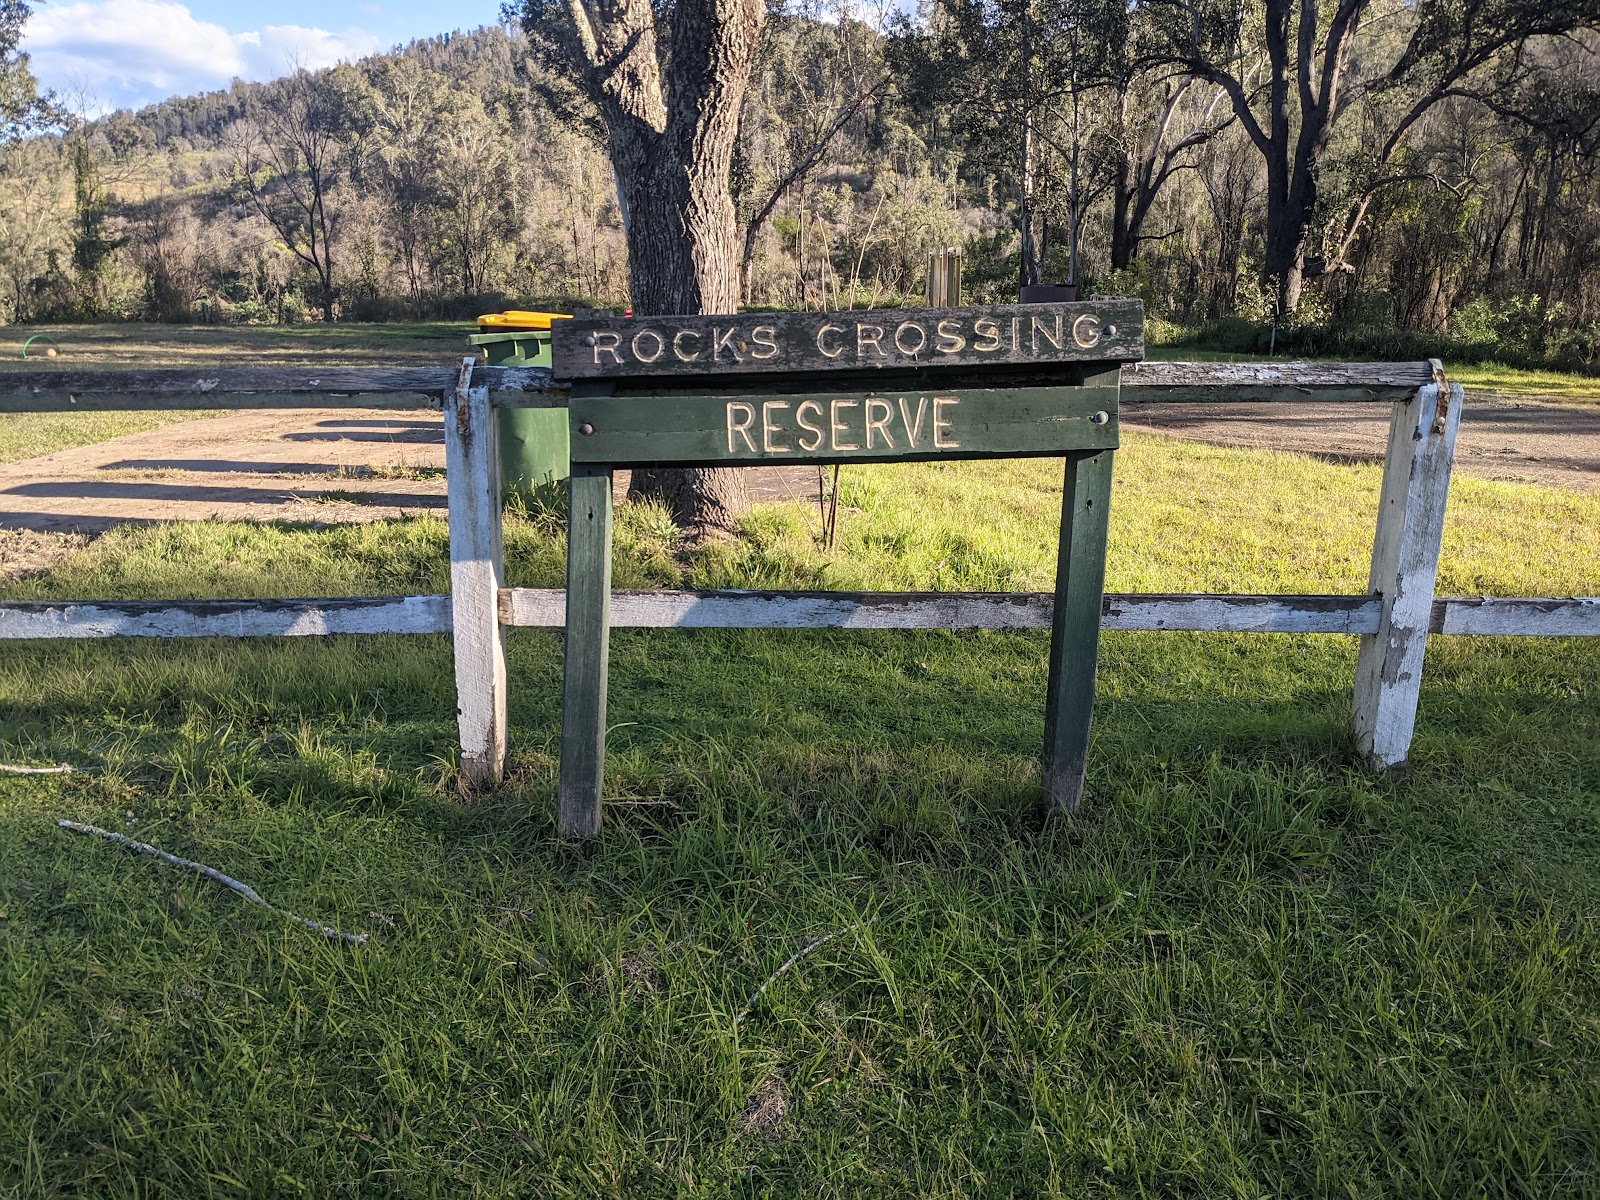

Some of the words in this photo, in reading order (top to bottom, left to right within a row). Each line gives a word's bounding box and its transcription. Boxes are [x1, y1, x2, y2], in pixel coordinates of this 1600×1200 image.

[592, 325, 780, 364] ROCKS
[816, 313, 1101, 357] CROSSING
[726, 396, 961, 453] RESERVE
